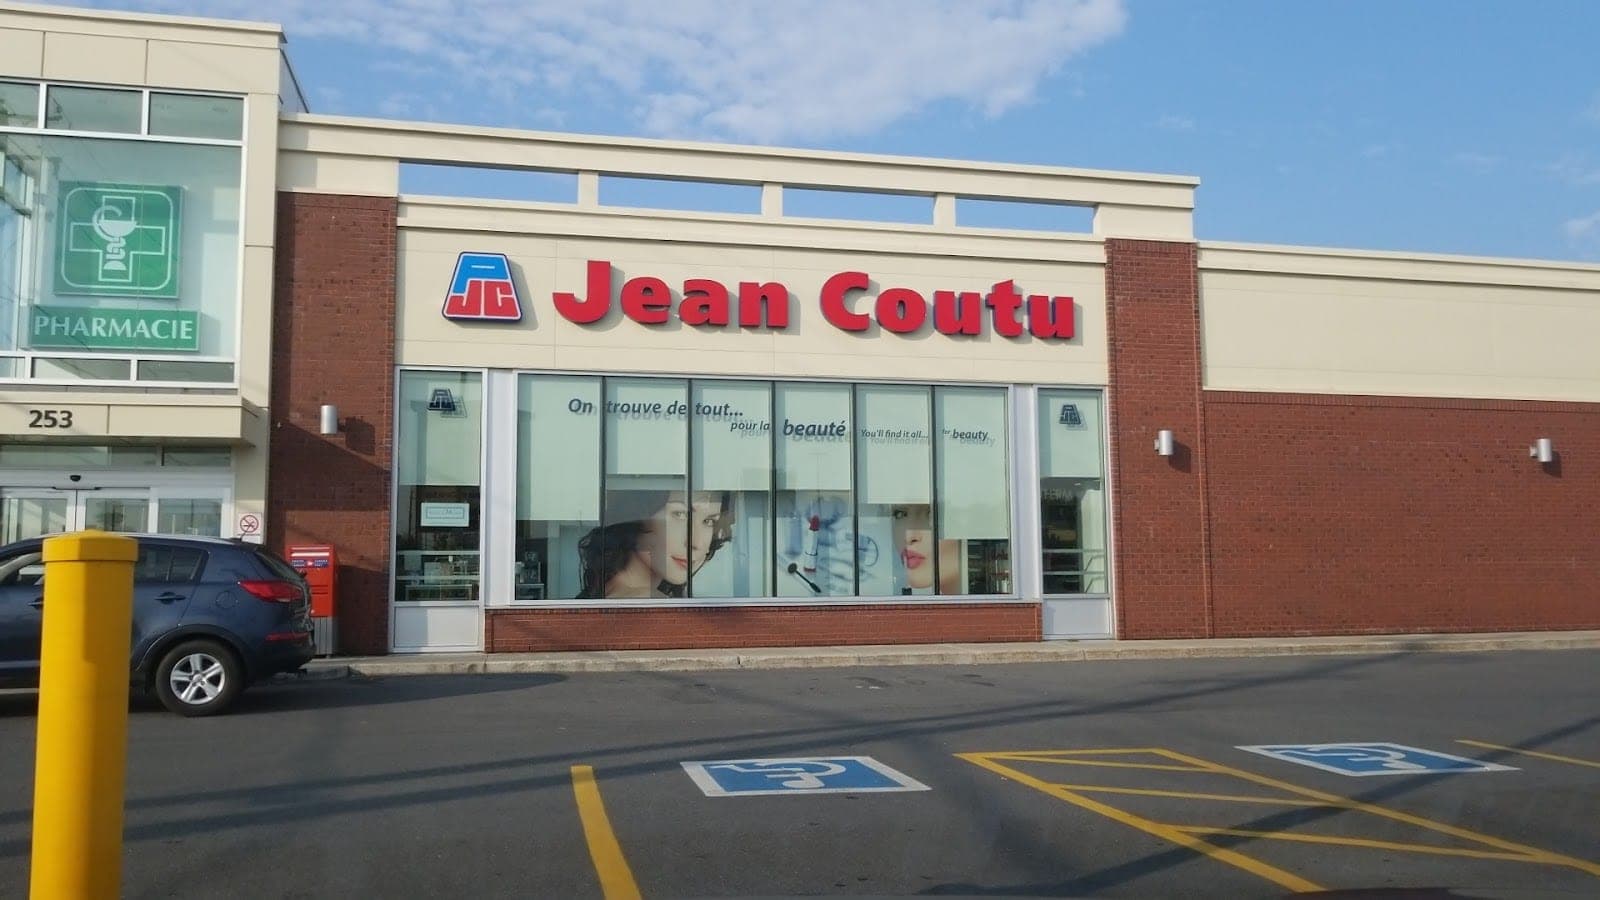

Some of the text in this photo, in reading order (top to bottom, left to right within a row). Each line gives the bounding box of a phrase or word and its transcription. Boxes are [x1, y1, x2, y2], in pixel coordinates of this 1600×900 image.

[553, 260, 1075, 339] Jean Coutu
[34, 315, 193, 340] PHARMACIE
[568, 398, 743, 416] On trouve de tout...
[28, 410, 73, 428] 253
[730, 418, 846, 436] pour la beauté
[861, 429, 883, 437] You'll
[885, 429, 902, 438] find
[952, 428, 989, 441] beauty
